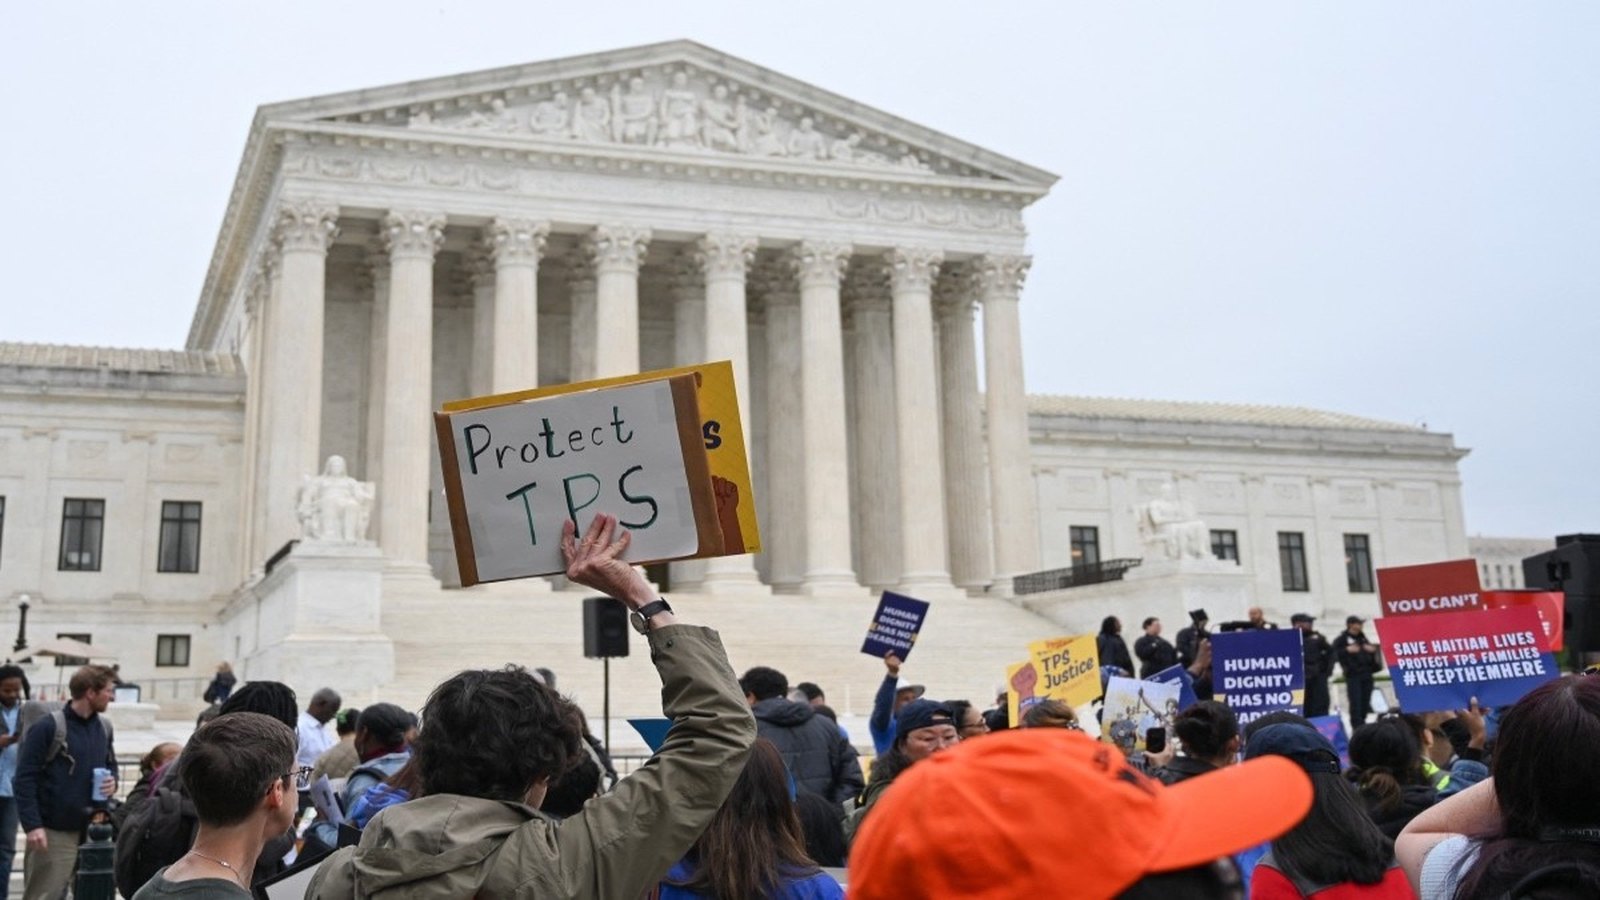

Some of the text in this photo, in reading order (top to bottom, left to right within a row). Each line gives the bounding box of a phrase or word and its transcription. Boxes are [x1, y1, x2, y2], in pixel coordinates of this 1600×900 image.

[463, 405, 633, 475] Protect
[505, 464, 658, 546] TPS
[1387, 593, 1479, 613] YOU CAN'T
[878, 614, 917, 631] DIGNITY
[884, 606, 919, 621] HUMAN
[867, 632, 912, 649] DEADLINE
[877, 625, 911, 640] HAS NO
[1393, 631, 1536, 656] SAVE HAITIAN LIVES
[1041, 649, 1070, 672] TPS
[1224, 656, 1290, 672] HUMAN
[1397, 647, 1540, 670] PROTECT TPS FAMILIES
[1043, 657, 1094, 689] Justice
[1224, 673, 1293, 690] DIGNITY
[1403, 659, 1546, 687] #KEEPTHEMHERE
[1227, 692, 1292, 707] HAS NO
